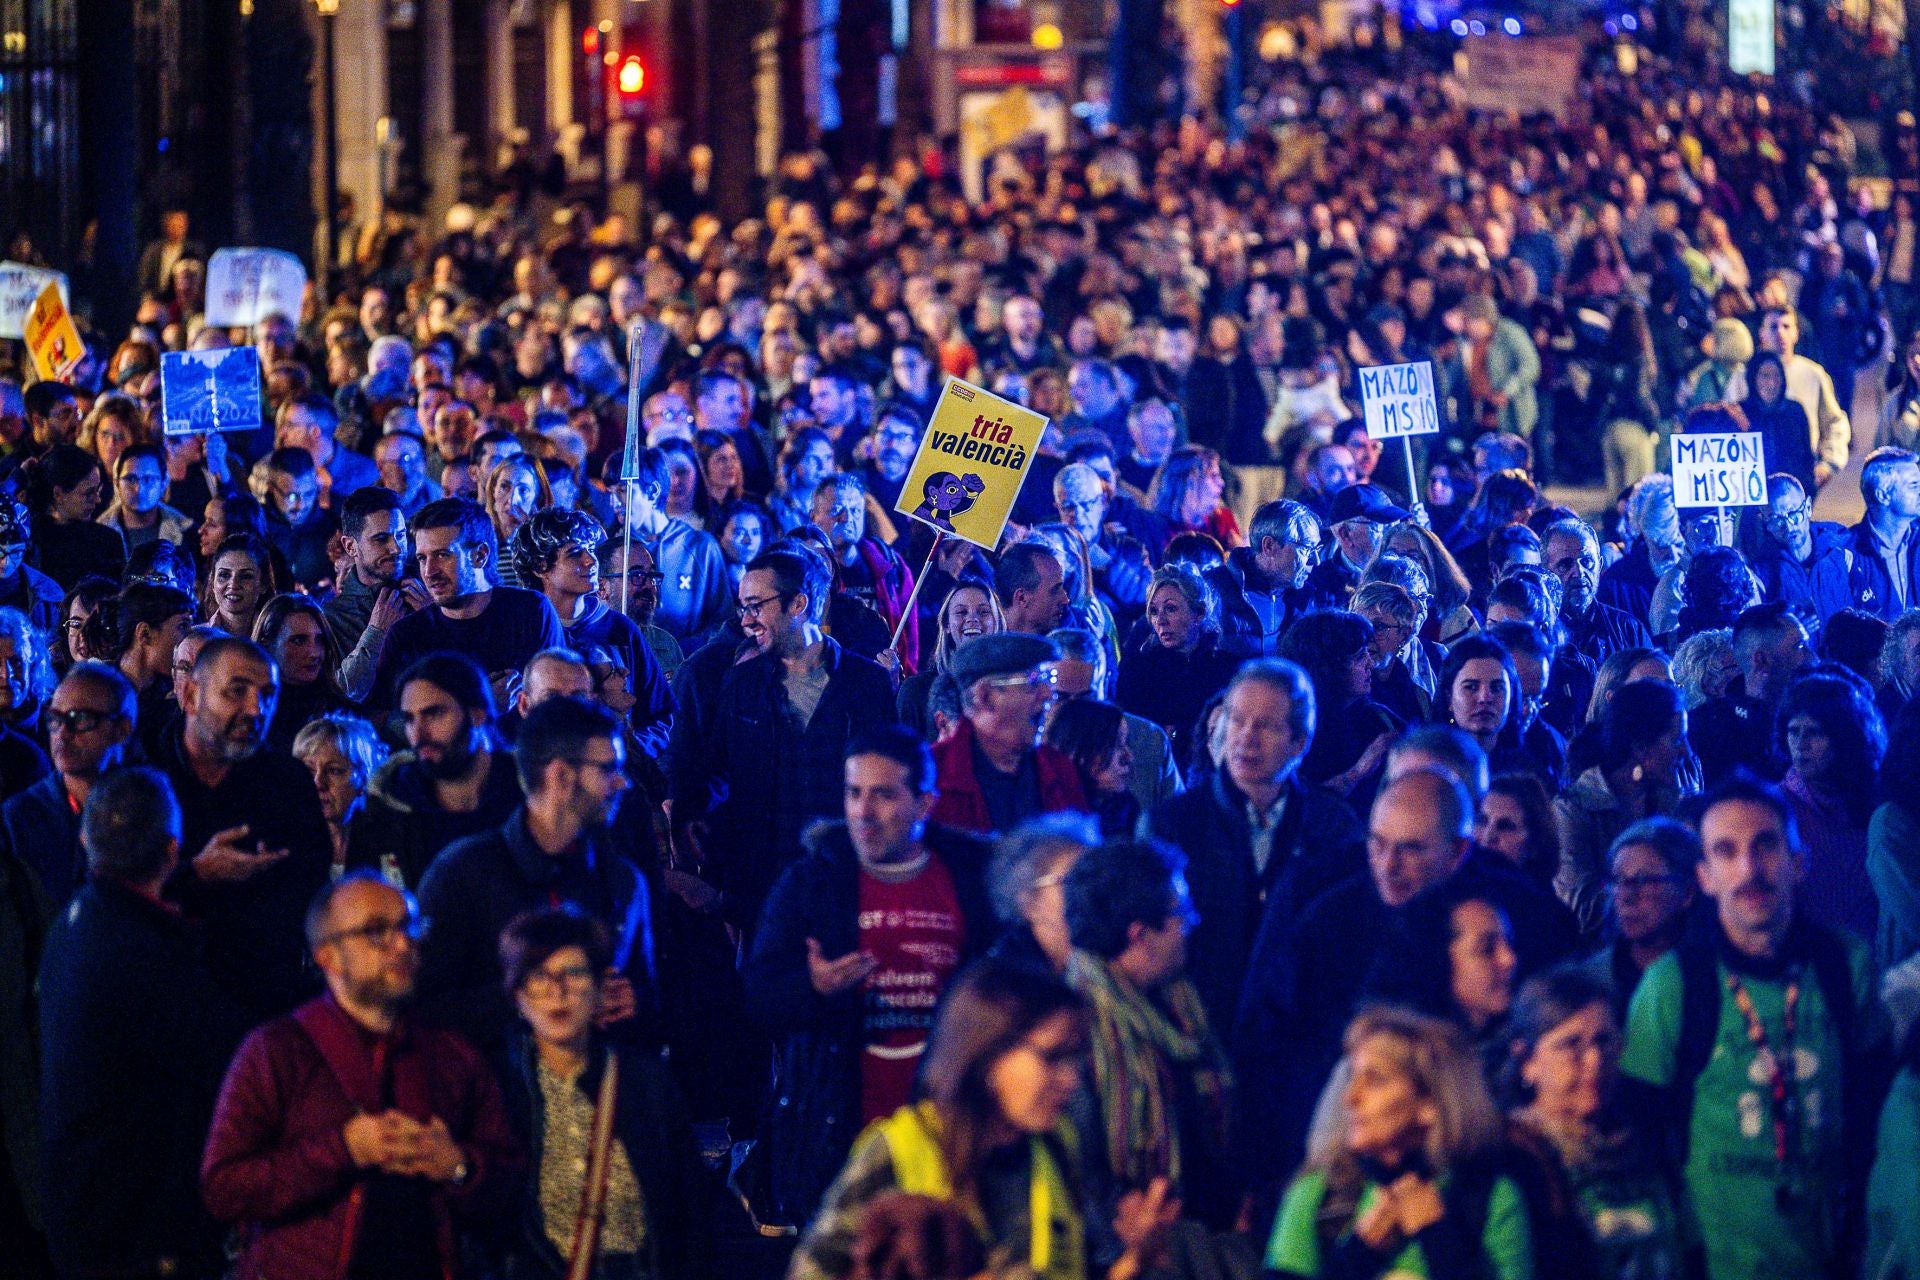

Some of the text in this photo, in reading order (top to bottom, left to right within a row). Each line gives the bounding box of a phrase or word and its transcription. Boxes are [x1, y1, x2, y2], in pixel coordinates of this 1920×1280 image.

[1362, 363, 1432, 400] MAZÓN
[970, 414, 1014, 445] tria
[931, 430, 1026, 470] valencià
[1678, 434, 1758, 464] MAZÓN
